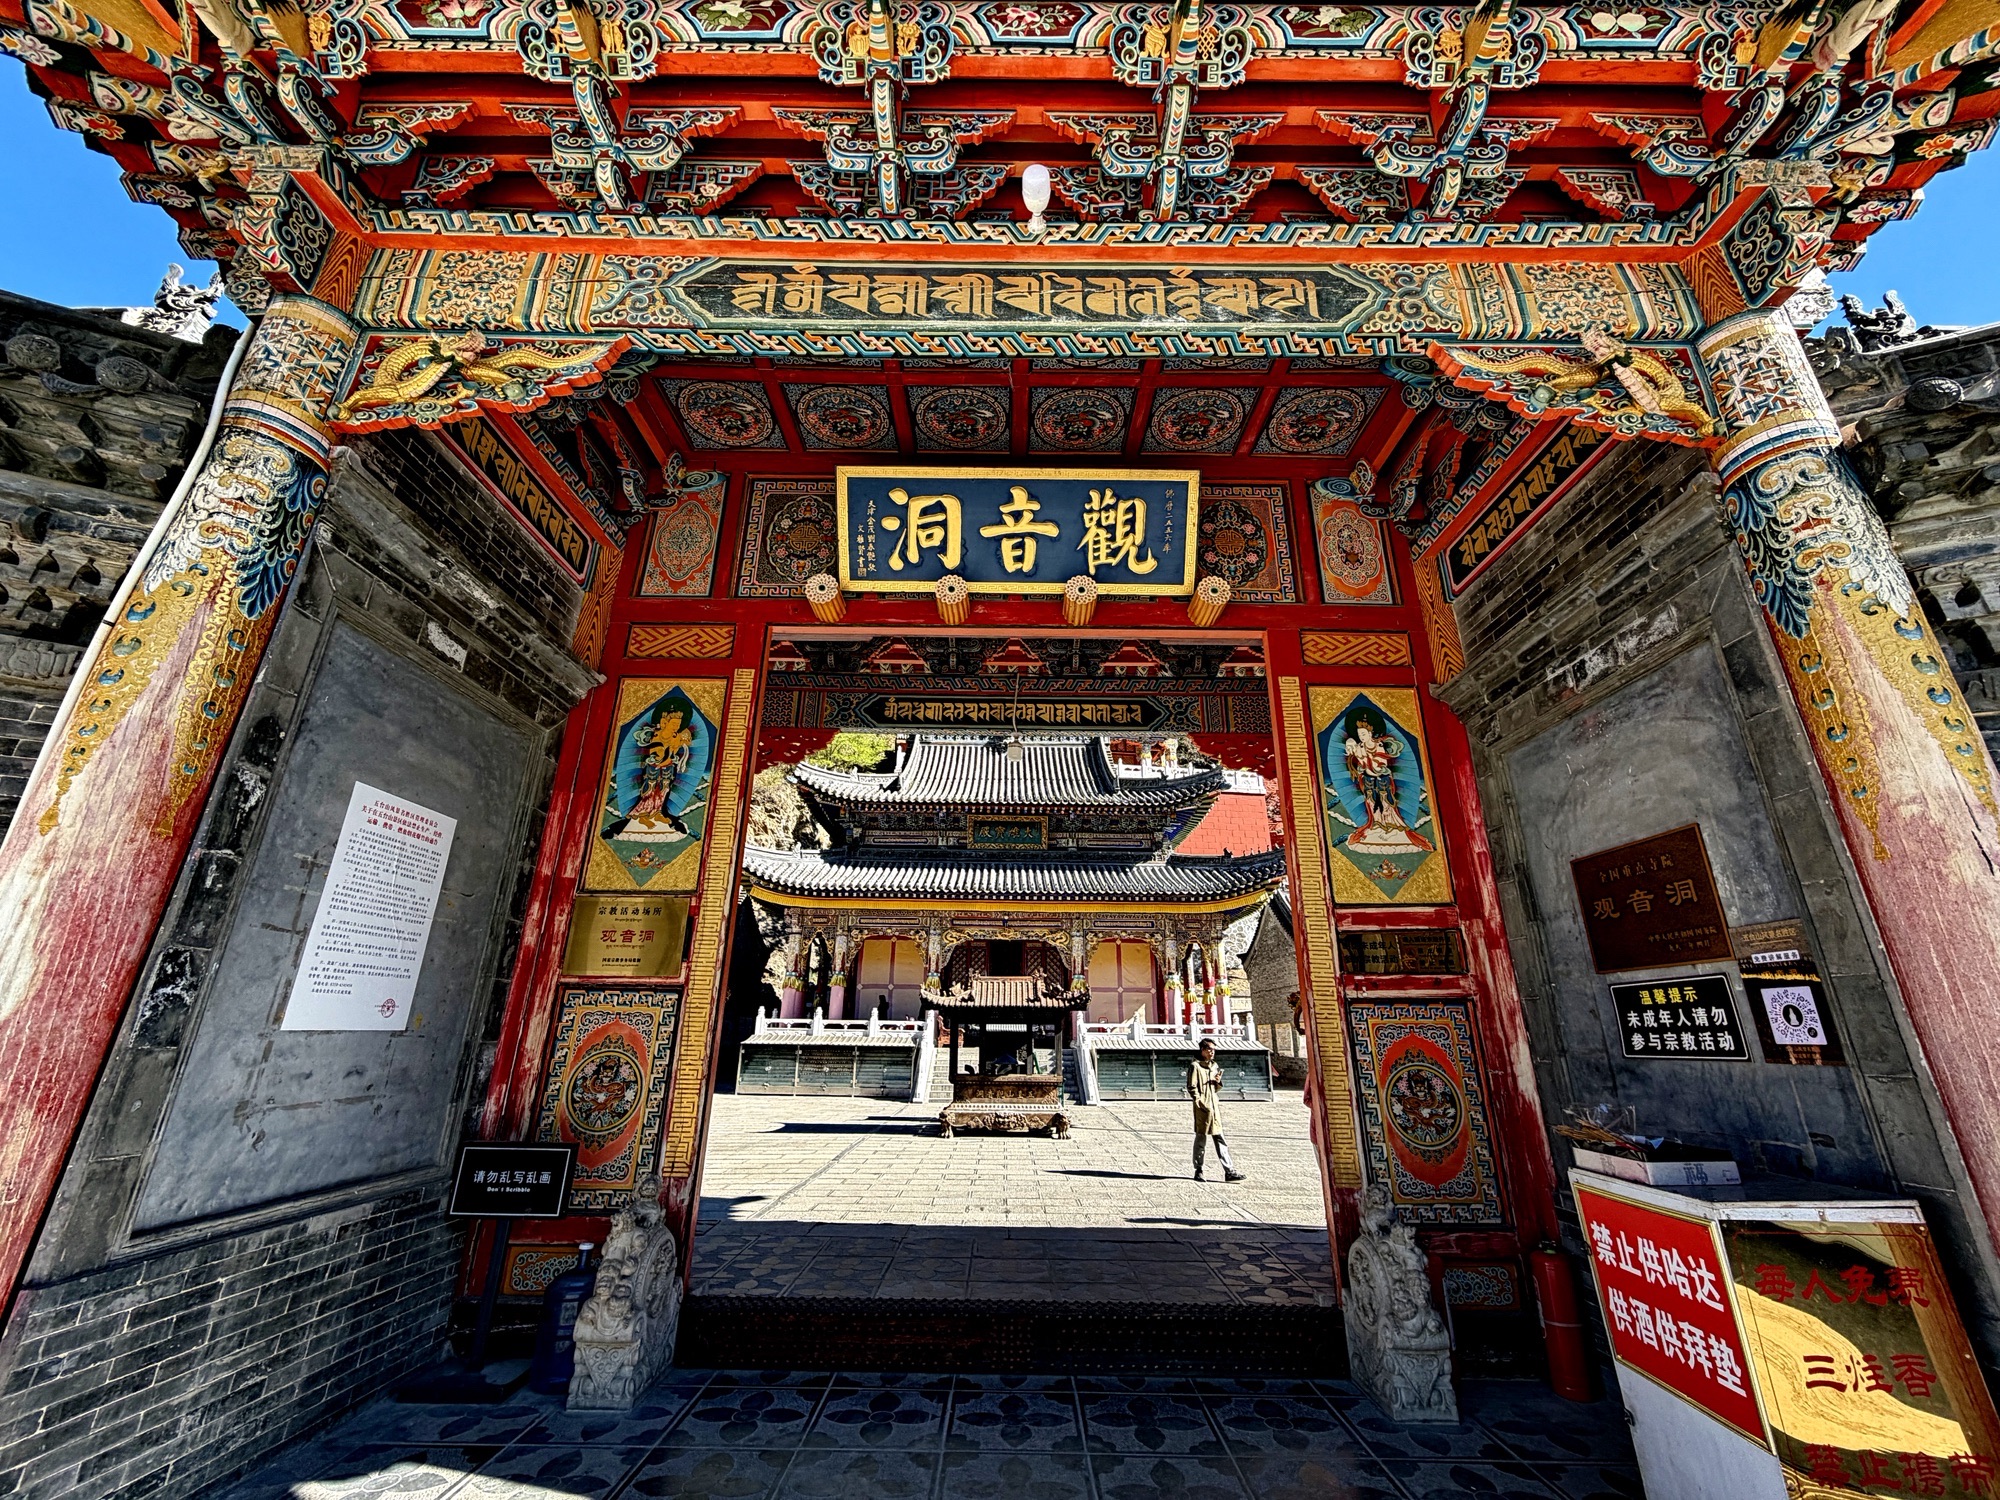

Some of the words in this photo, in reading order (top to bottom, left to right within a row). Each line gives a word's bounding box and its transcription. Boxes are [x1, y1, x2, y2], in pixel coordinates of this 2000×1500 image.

[881, 485, 1158, 576] 觀音洞
[598, 906, 663, 916] 宗教活动场所
[1593, 878, 1698, 920] 观音洞
[600, 929, 655, 943] 观音洞
[1753, 951, 1798, 963] 免费讲解服务
[1639, 986, 1698, 1005] 温馨提示
[1627, 1006, 1728, 1028] 未成年人请勿
[1630, 1031, 1735, 1051] 参与宗教活动
[473, 1170, 552, 1184] 请勿乱写乱画
[1590, 1220, 1724, 1312] 禁止供哈达
[1754, 1263, 1931, 1308] 每人免费
[1607, 1286, 1747, 1398] 供酒供拜垫
[1803, 1354, 1937, 1398] 三炷香
[1804, 1443, 1995, 1498] 禁止携带
